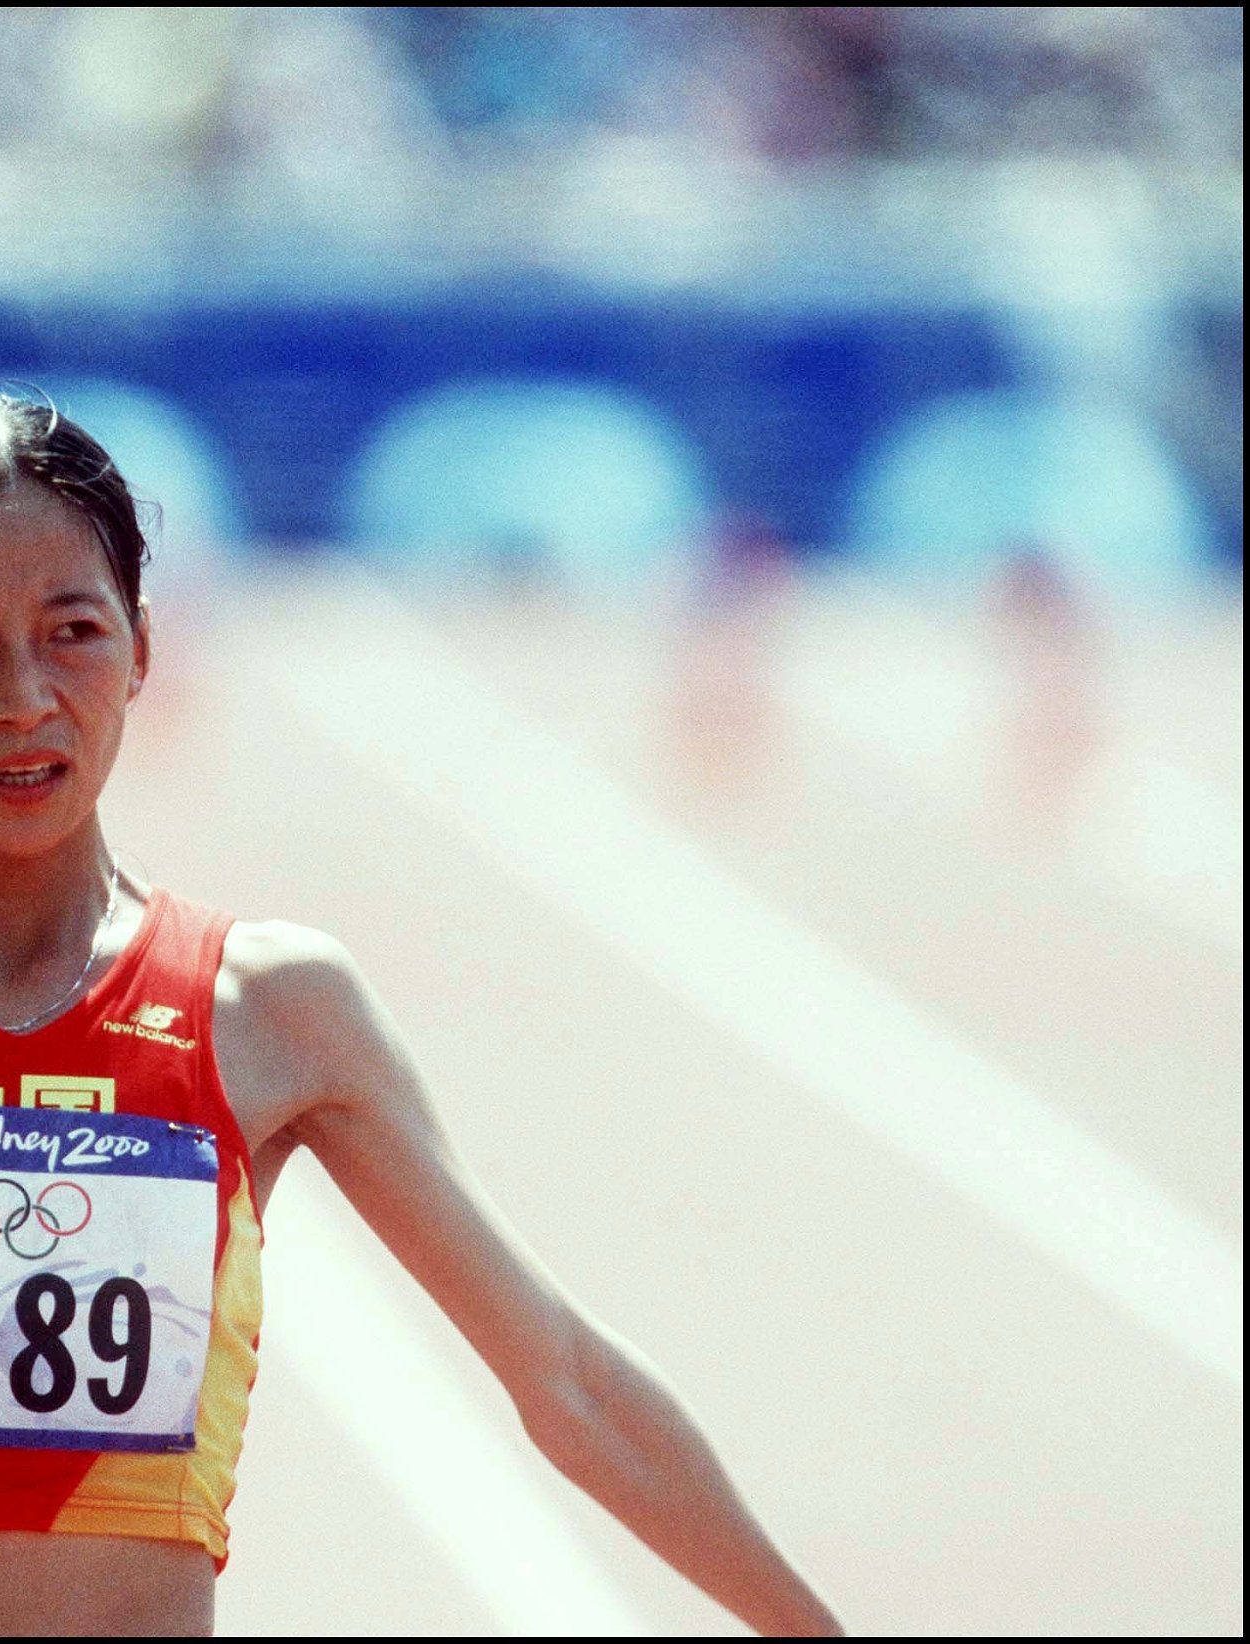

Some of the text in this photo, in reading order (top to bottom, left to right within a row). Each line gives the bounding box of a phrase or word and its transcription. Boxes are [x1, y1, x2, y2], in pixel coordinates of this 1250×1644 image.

[103, 1020, 196, 1050] new balance
[62, 1127, 150, 1166] 2000
